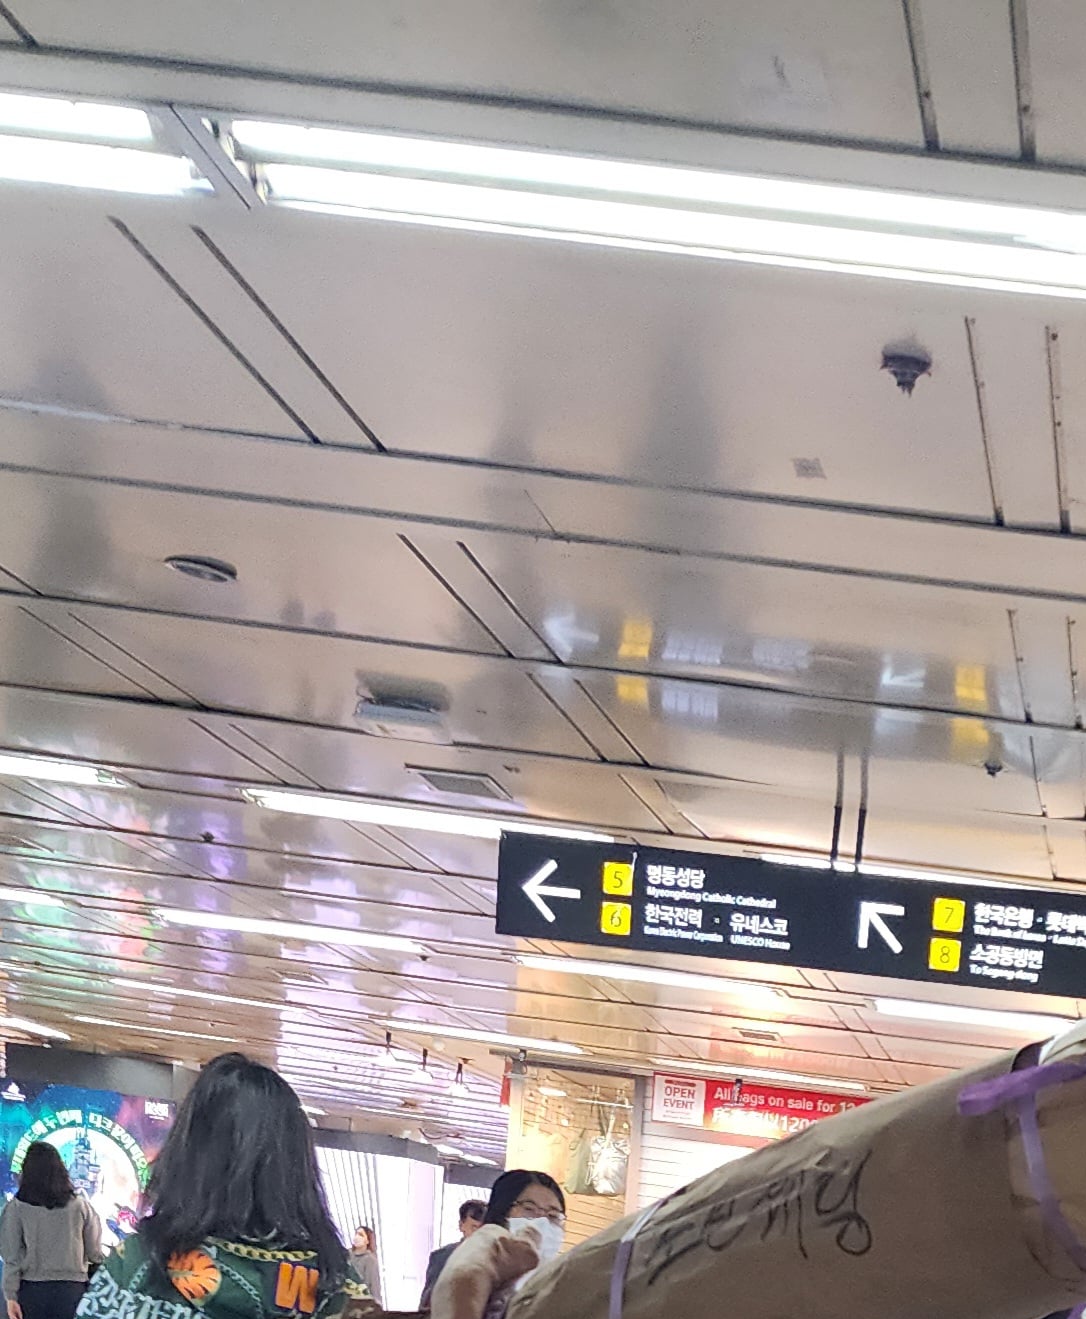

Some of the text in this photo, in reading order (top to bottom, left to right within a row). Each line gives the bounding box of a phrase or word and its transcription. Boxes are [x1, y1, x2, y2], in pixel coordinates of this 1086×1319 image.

[612, 870, 623, 889] 5
[646, 864, 705, 888] 명동성당
[646, 885, 701, 903] Myeongdong
[736, 895, 777, 909] Cathedral
[610, 908, 622, 928] 6
[644, 903, 788, 936] 한국전력 유네스코
[944, 906, 955, 924] 7
[973, 902, 1035, 929] 한국은행
[939, 945, 950, 963] 8
[969, 943, 1044, 969] 소공동방면
[664, 1086, 696, 1099] OPEN
[714, 1087, 731, 1101] All
[768, 1096, 784, 1107] on
[787, 1097, 813, 1110] sale
[817, 1099, 835, 1112] for
[663, 1098, 695, 1110] EVENT
